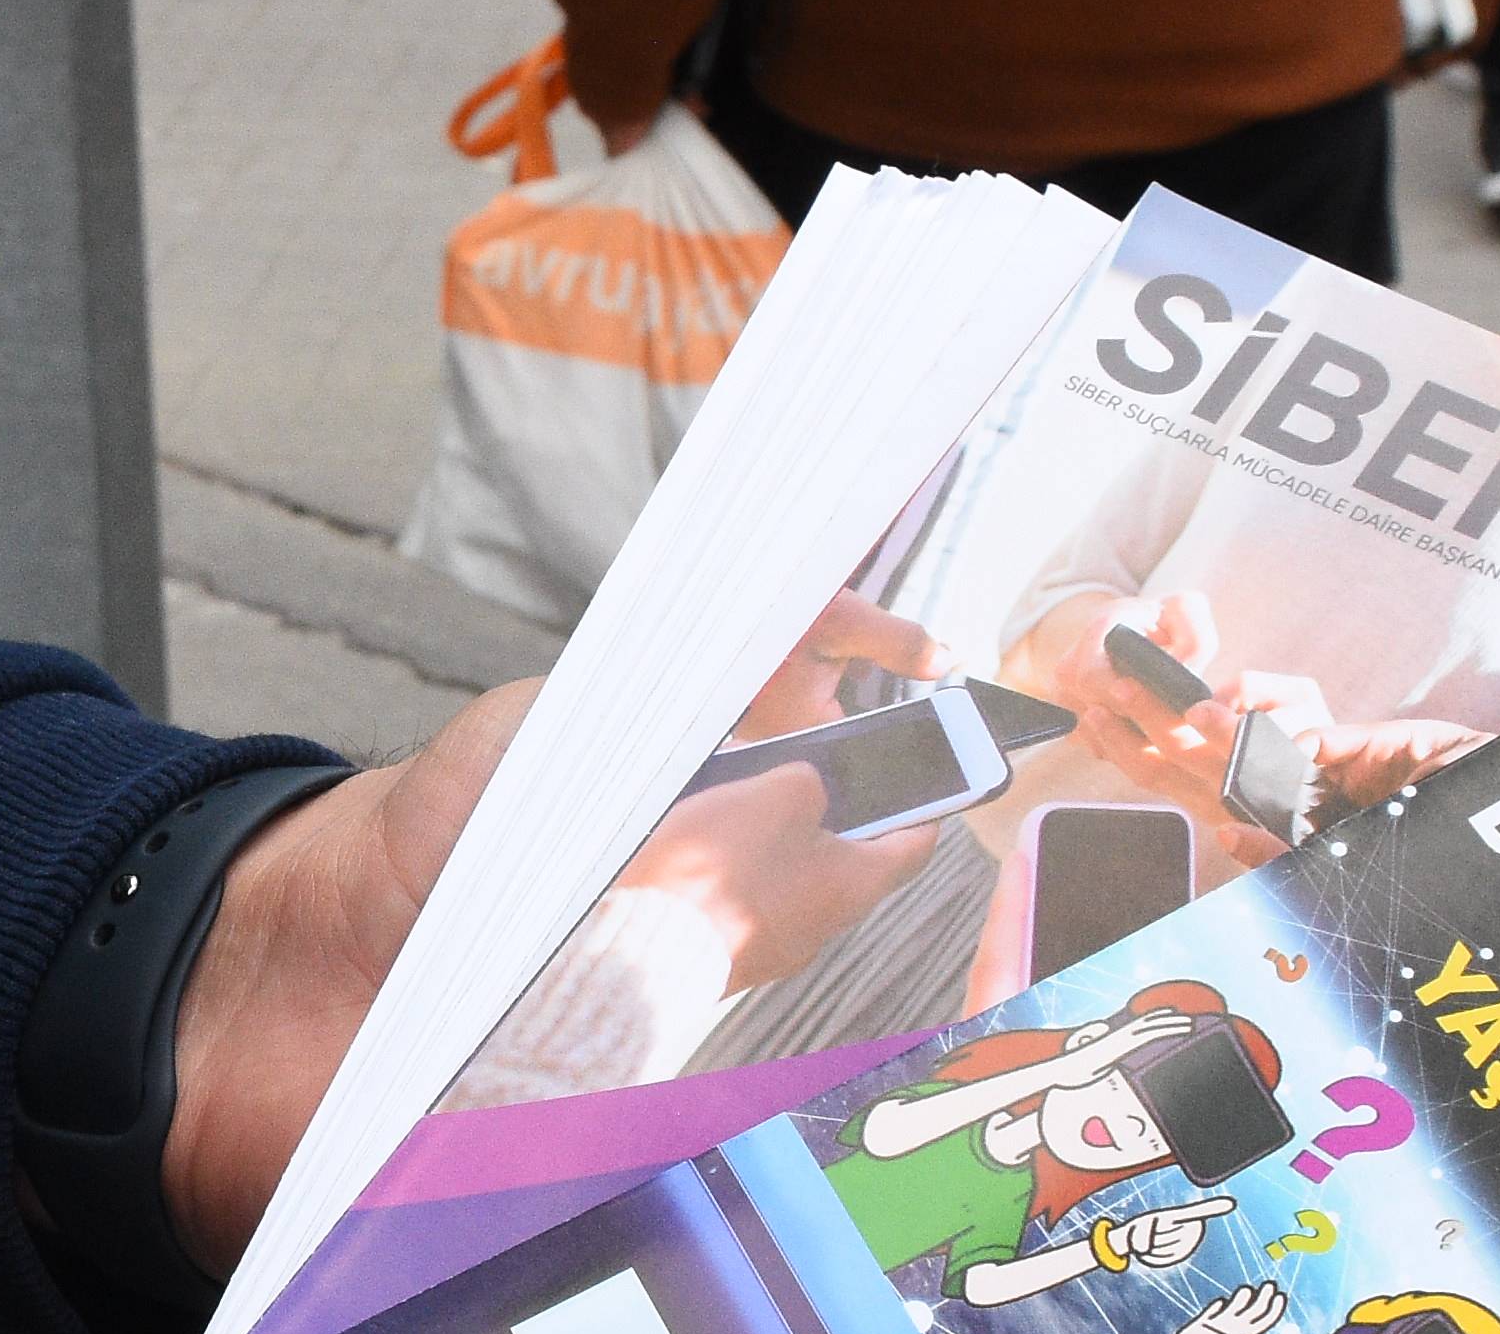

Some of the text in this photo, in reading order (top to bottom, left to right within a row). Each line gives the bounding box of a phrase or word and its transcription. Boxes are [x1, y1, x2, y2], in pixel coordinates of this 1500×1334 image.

[1063, 374, 1124, 412] SİBER
[1122, 403, 1230, 462] SUÇLARLA
[1232, 453, 1349, 515] MÜCADELE
[1349, 504, 1416, 544] DAİRE
